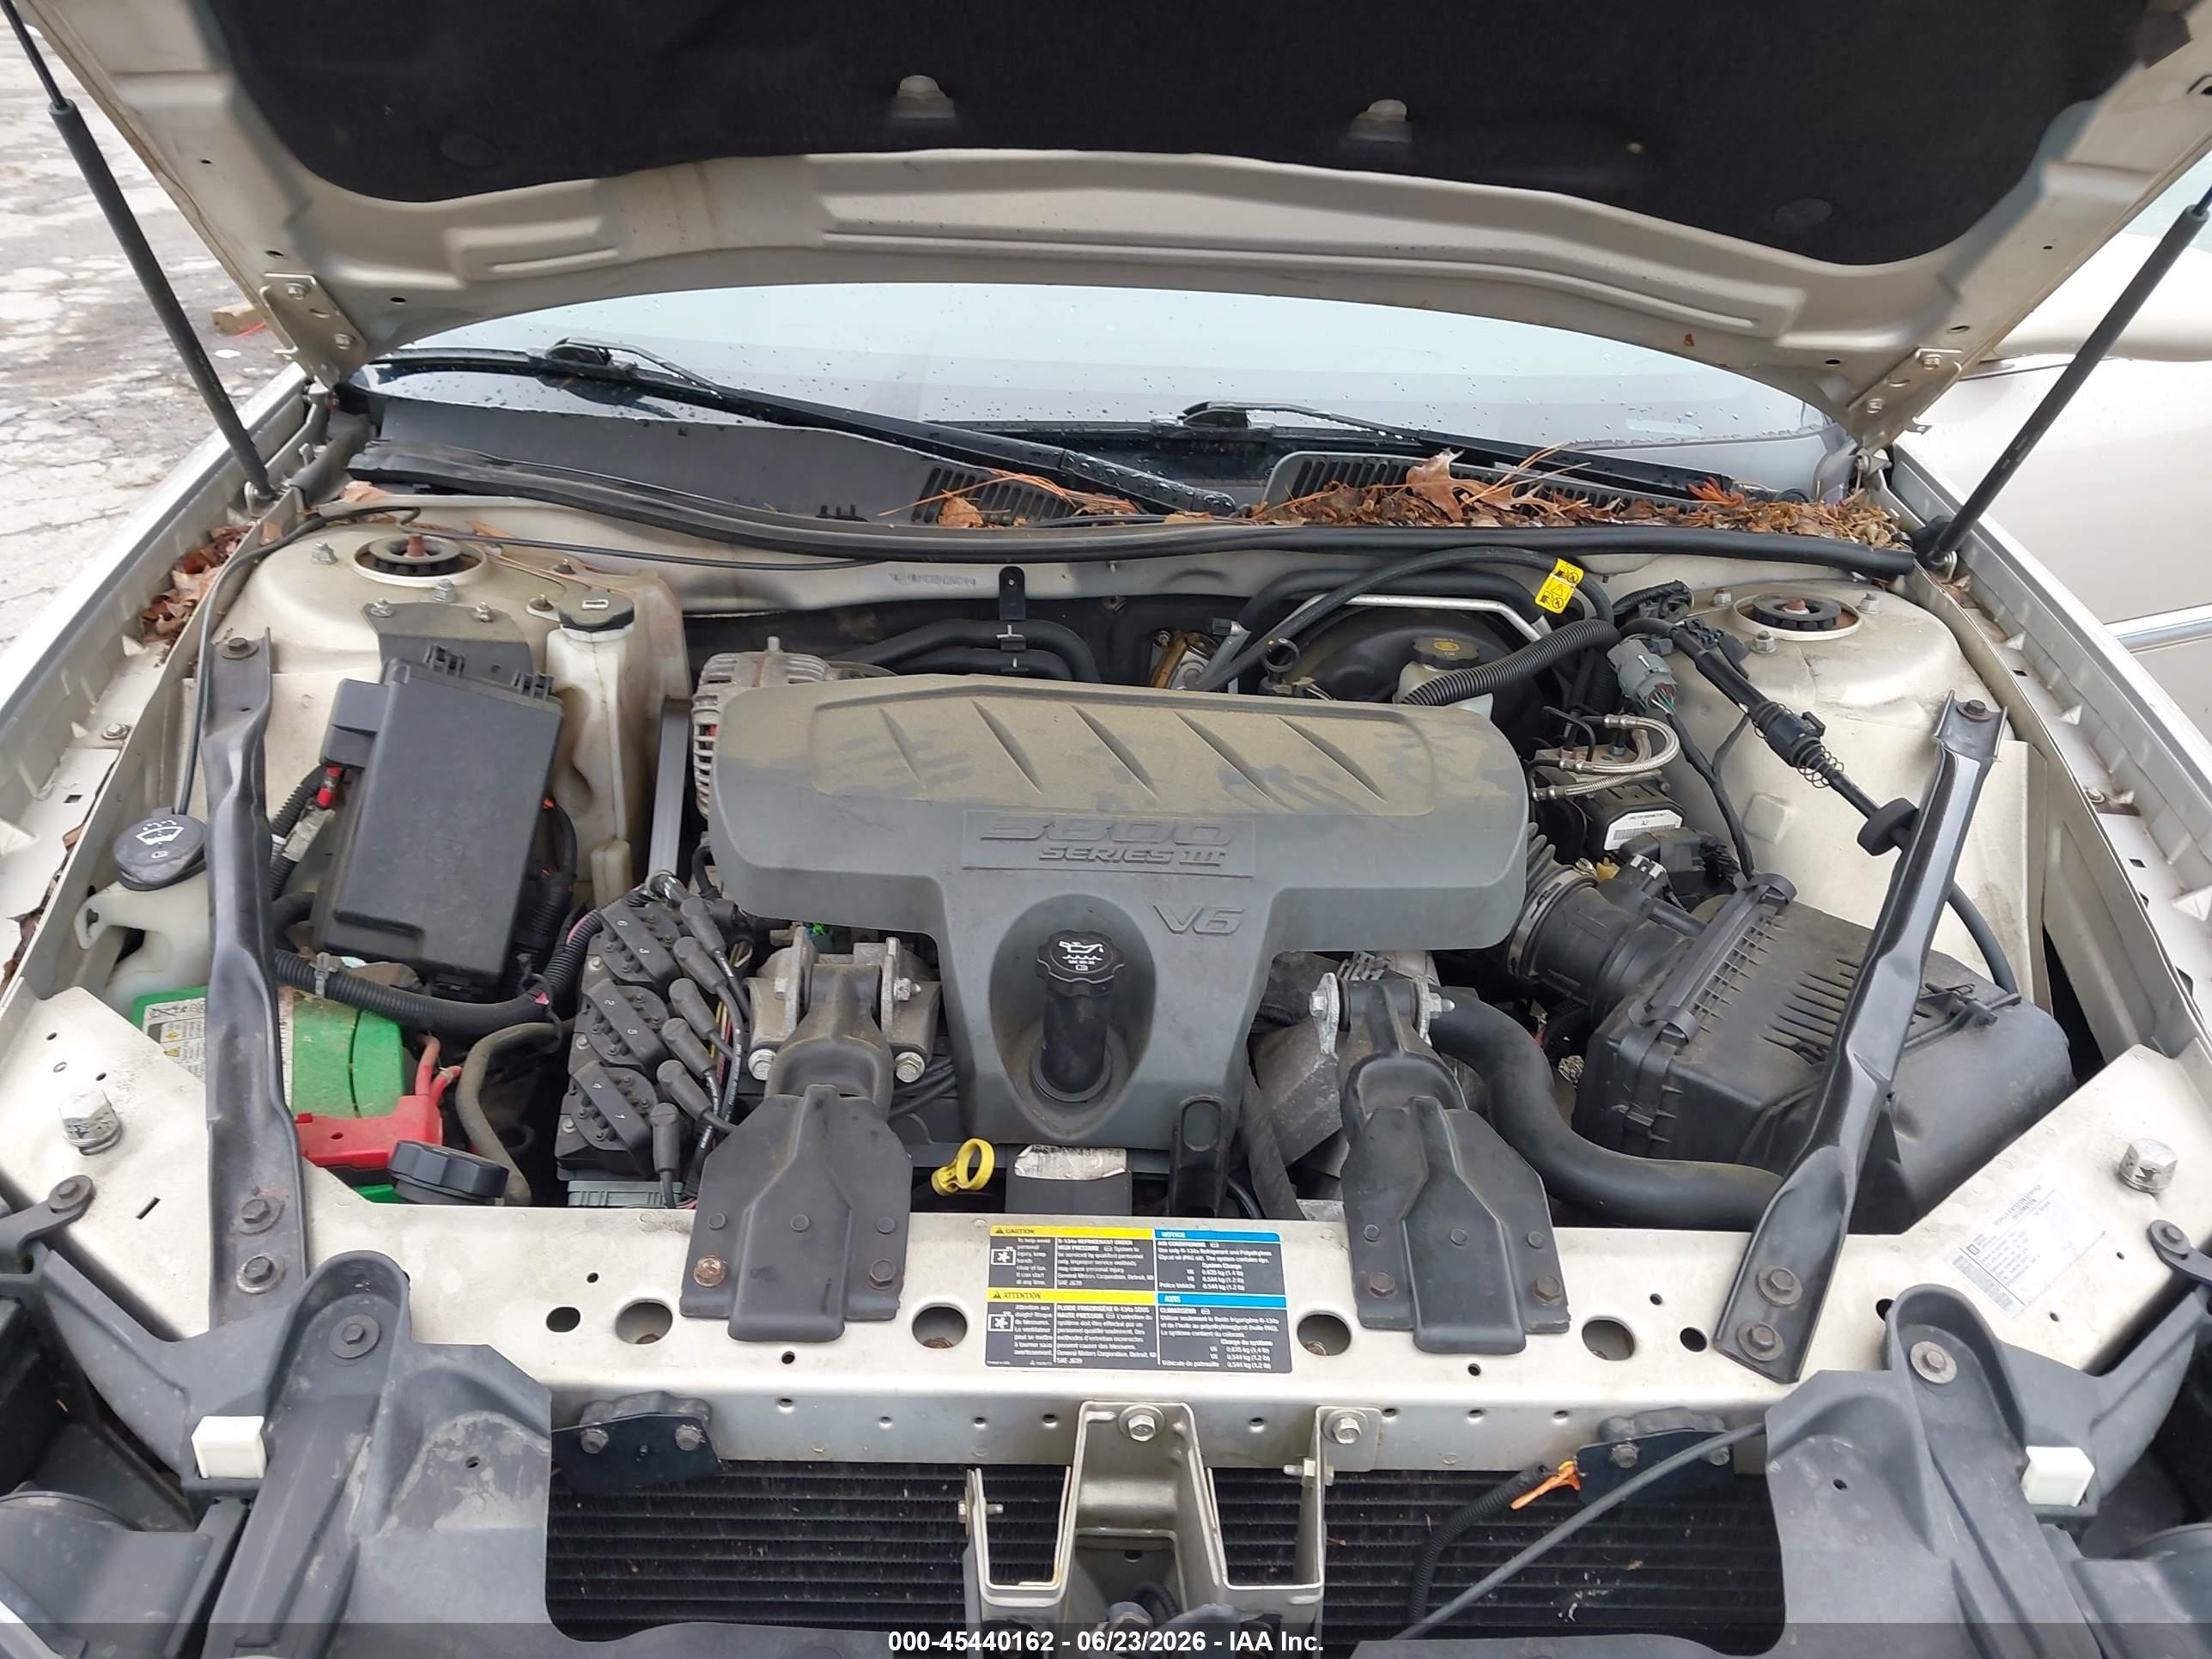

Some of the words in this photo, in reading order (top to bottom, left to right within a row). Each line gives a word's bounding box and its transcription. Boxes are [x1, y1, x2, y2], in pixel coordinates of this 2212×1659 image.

[981, 817, 1237, 846] 3800
[1039, 846, 1173, 865] SERIES
[1179, 848, 1225, 866] III
[1153, 905, 1243, 935] V6
[604, 998, 617, 1006] 2
